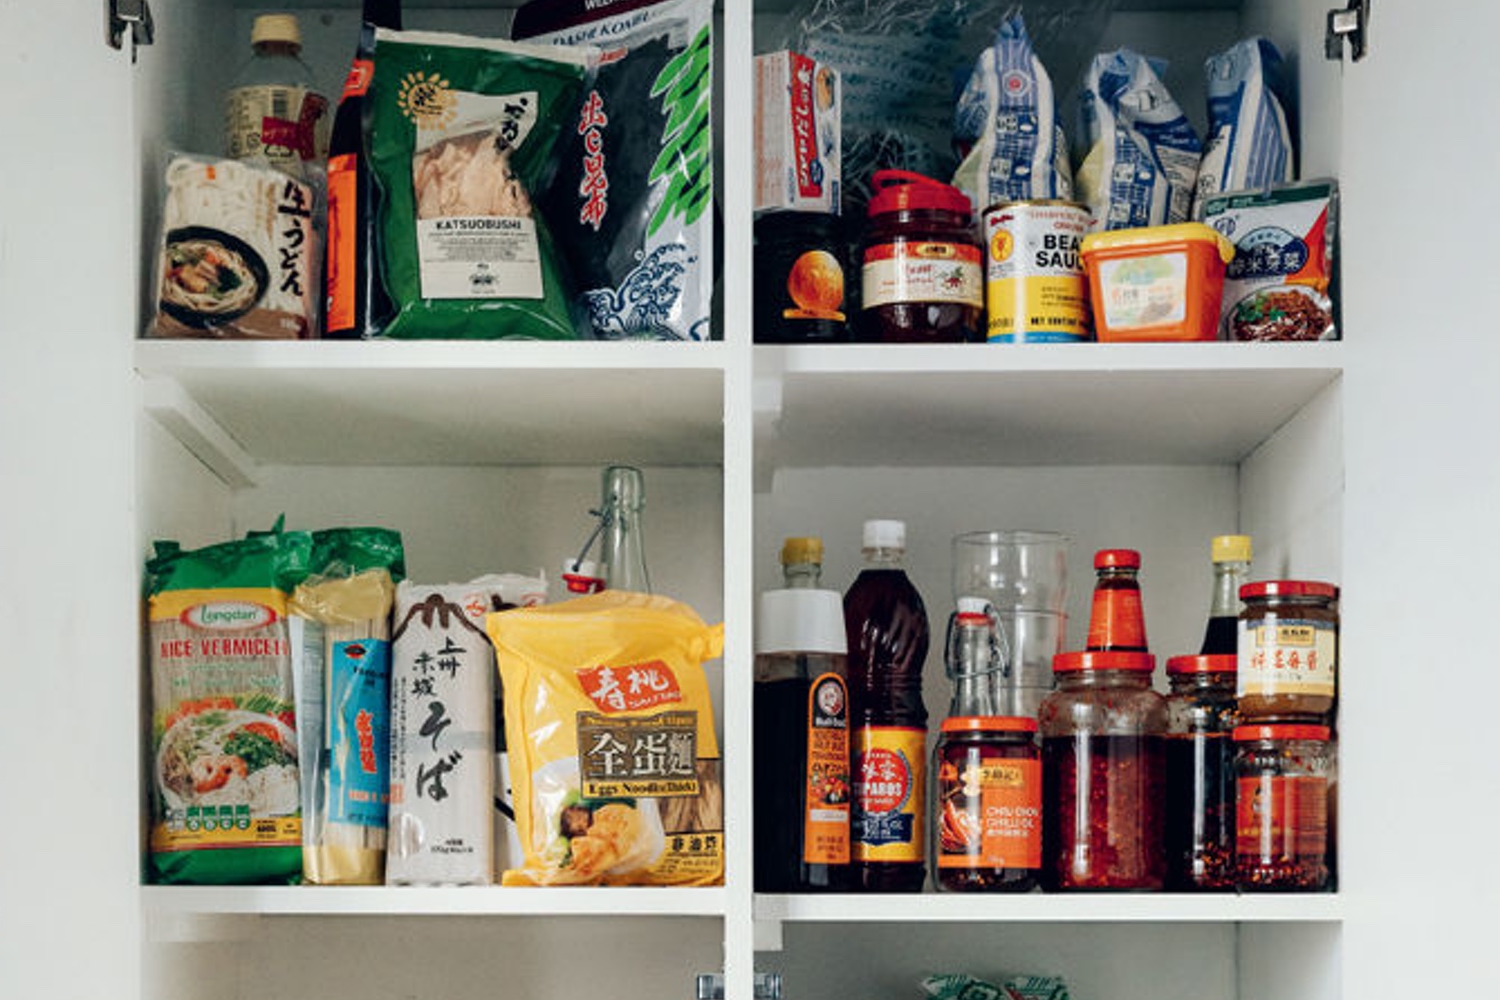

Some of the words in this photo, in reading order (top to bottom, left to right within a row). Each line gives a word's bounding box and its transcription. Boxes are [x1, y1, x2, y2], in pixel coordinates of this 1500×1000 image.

[436, 219, 521, 230] KATSUOBUSHI
[1044, 234, 1084, 251] BEA
[160, 638, 192, 658] RICE
[416, 701, 463, 803] そば
